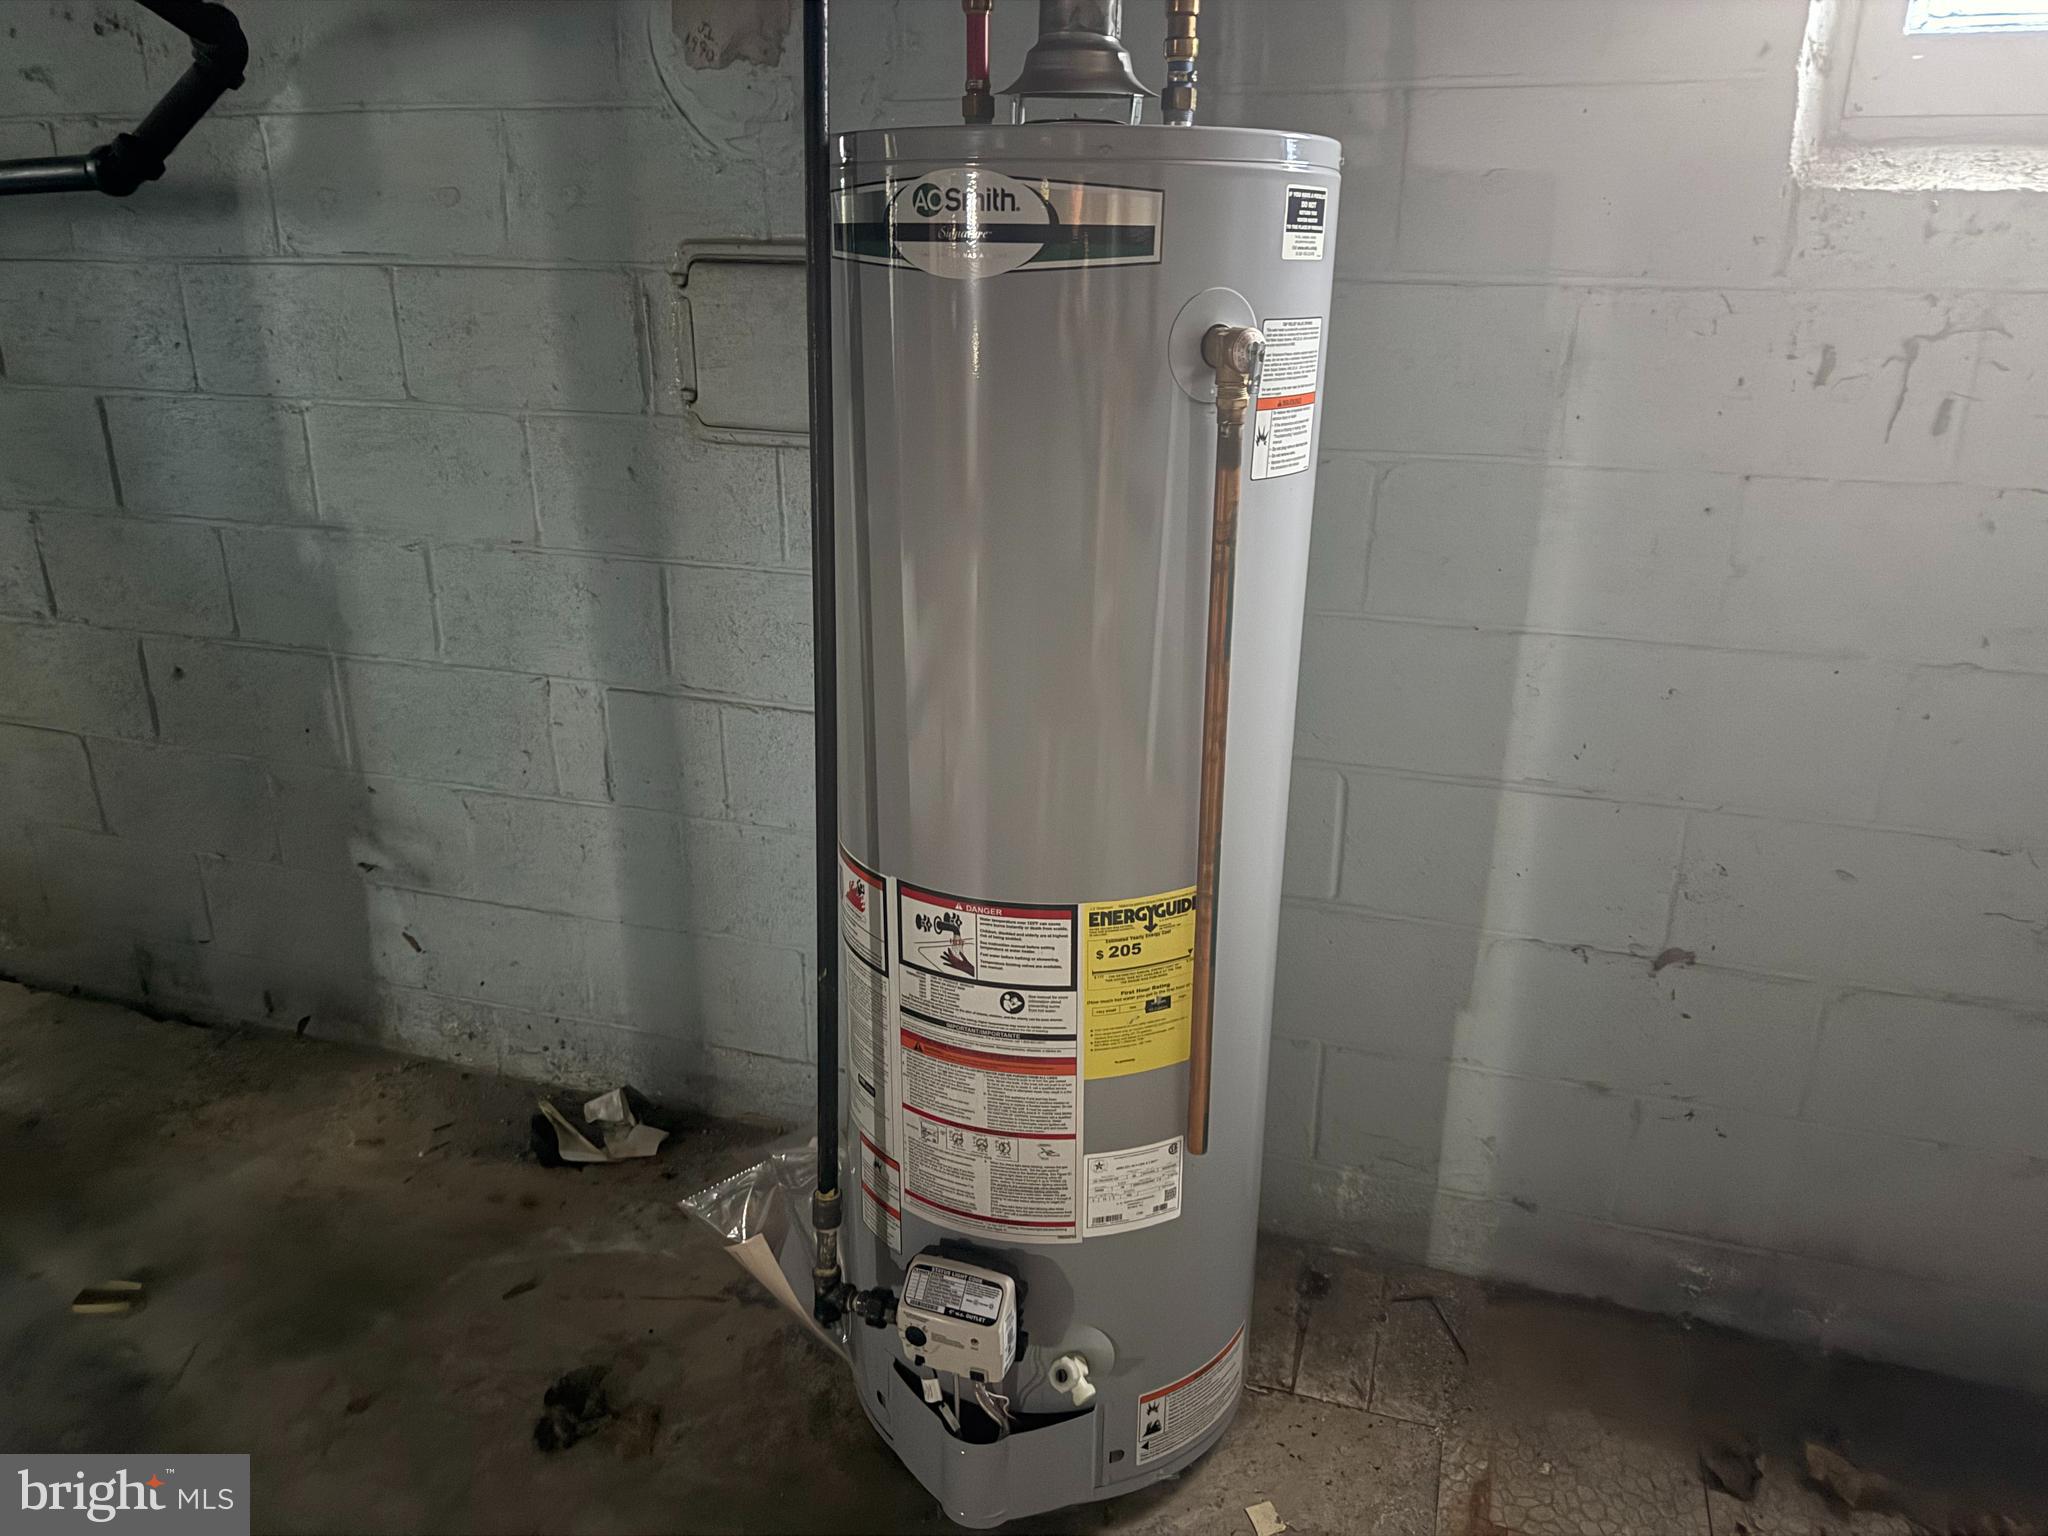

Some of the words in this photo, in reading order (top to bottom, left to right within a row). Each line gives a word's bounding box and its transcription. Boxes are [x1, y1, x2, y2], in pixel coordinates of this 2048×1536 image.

[966, 904, 1002, 915] DANGER
[1096, 950, 1104, 960] $
[1108, 943, 1142, 958] 205
[966, 1312, 986, 1323] OUTLET
